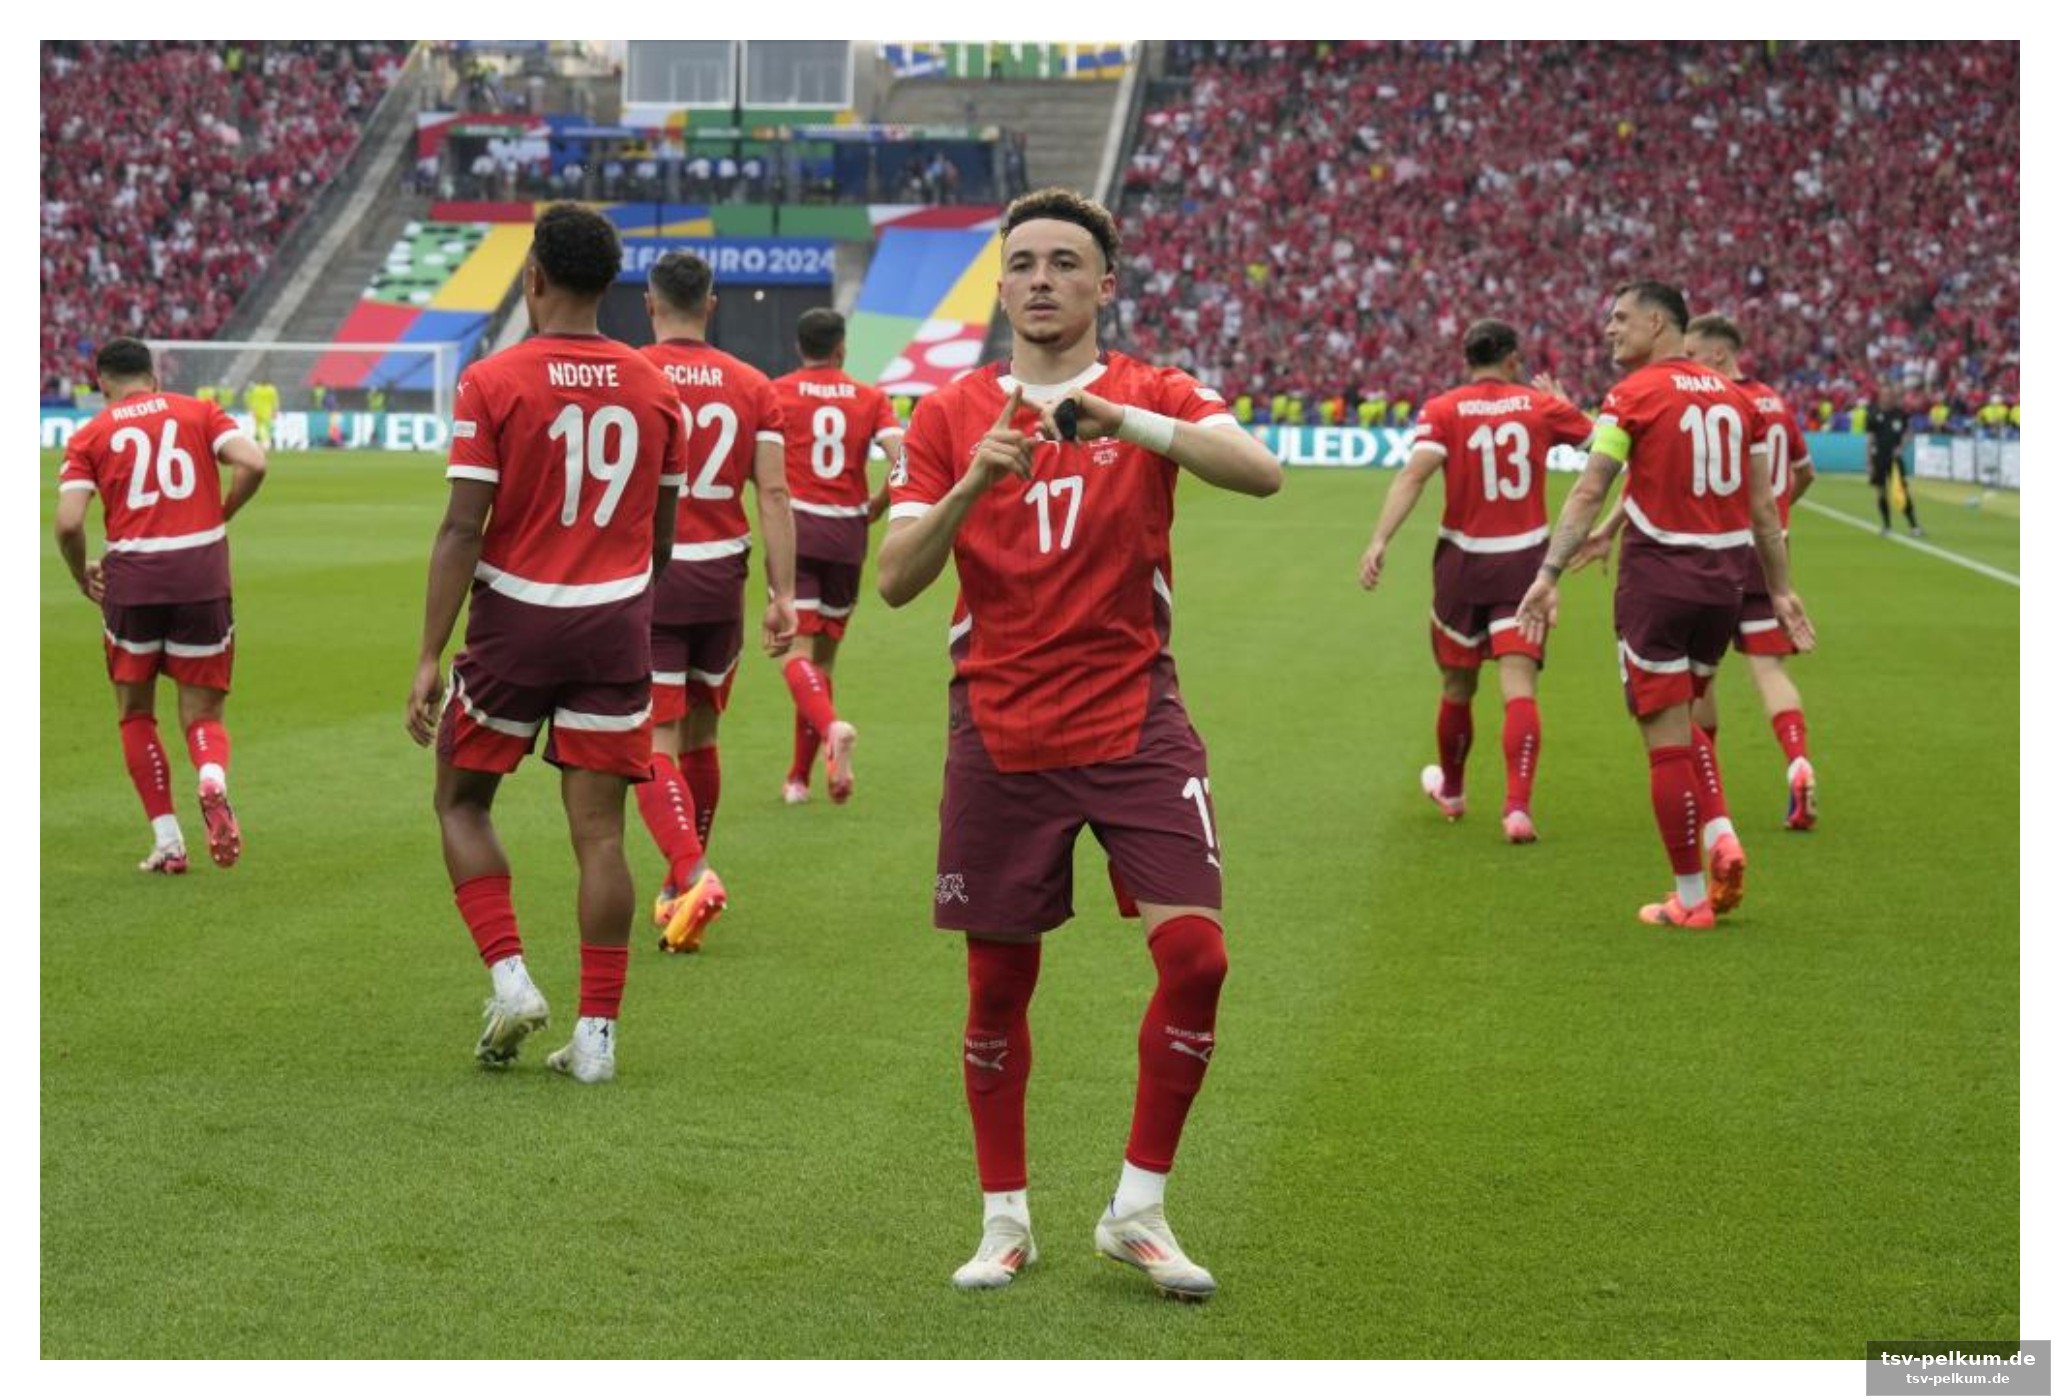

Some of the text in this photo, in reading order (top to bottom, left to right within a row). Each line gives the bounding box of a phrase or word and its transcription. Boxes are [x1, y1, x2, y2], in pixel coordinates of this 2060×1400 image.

[112, 398, 169, 421] RIEDER
[548, 363, 619, 387] NDOYE
[110, 418, 196, 510] 26
[548, 404, 639, 527] 19
[811, 405, 847, 480] 8
[1467, 421, 1532, 501] 13
[1680, 403, 1742, 496] 10
[1025, 474, 1083, 554] 17
